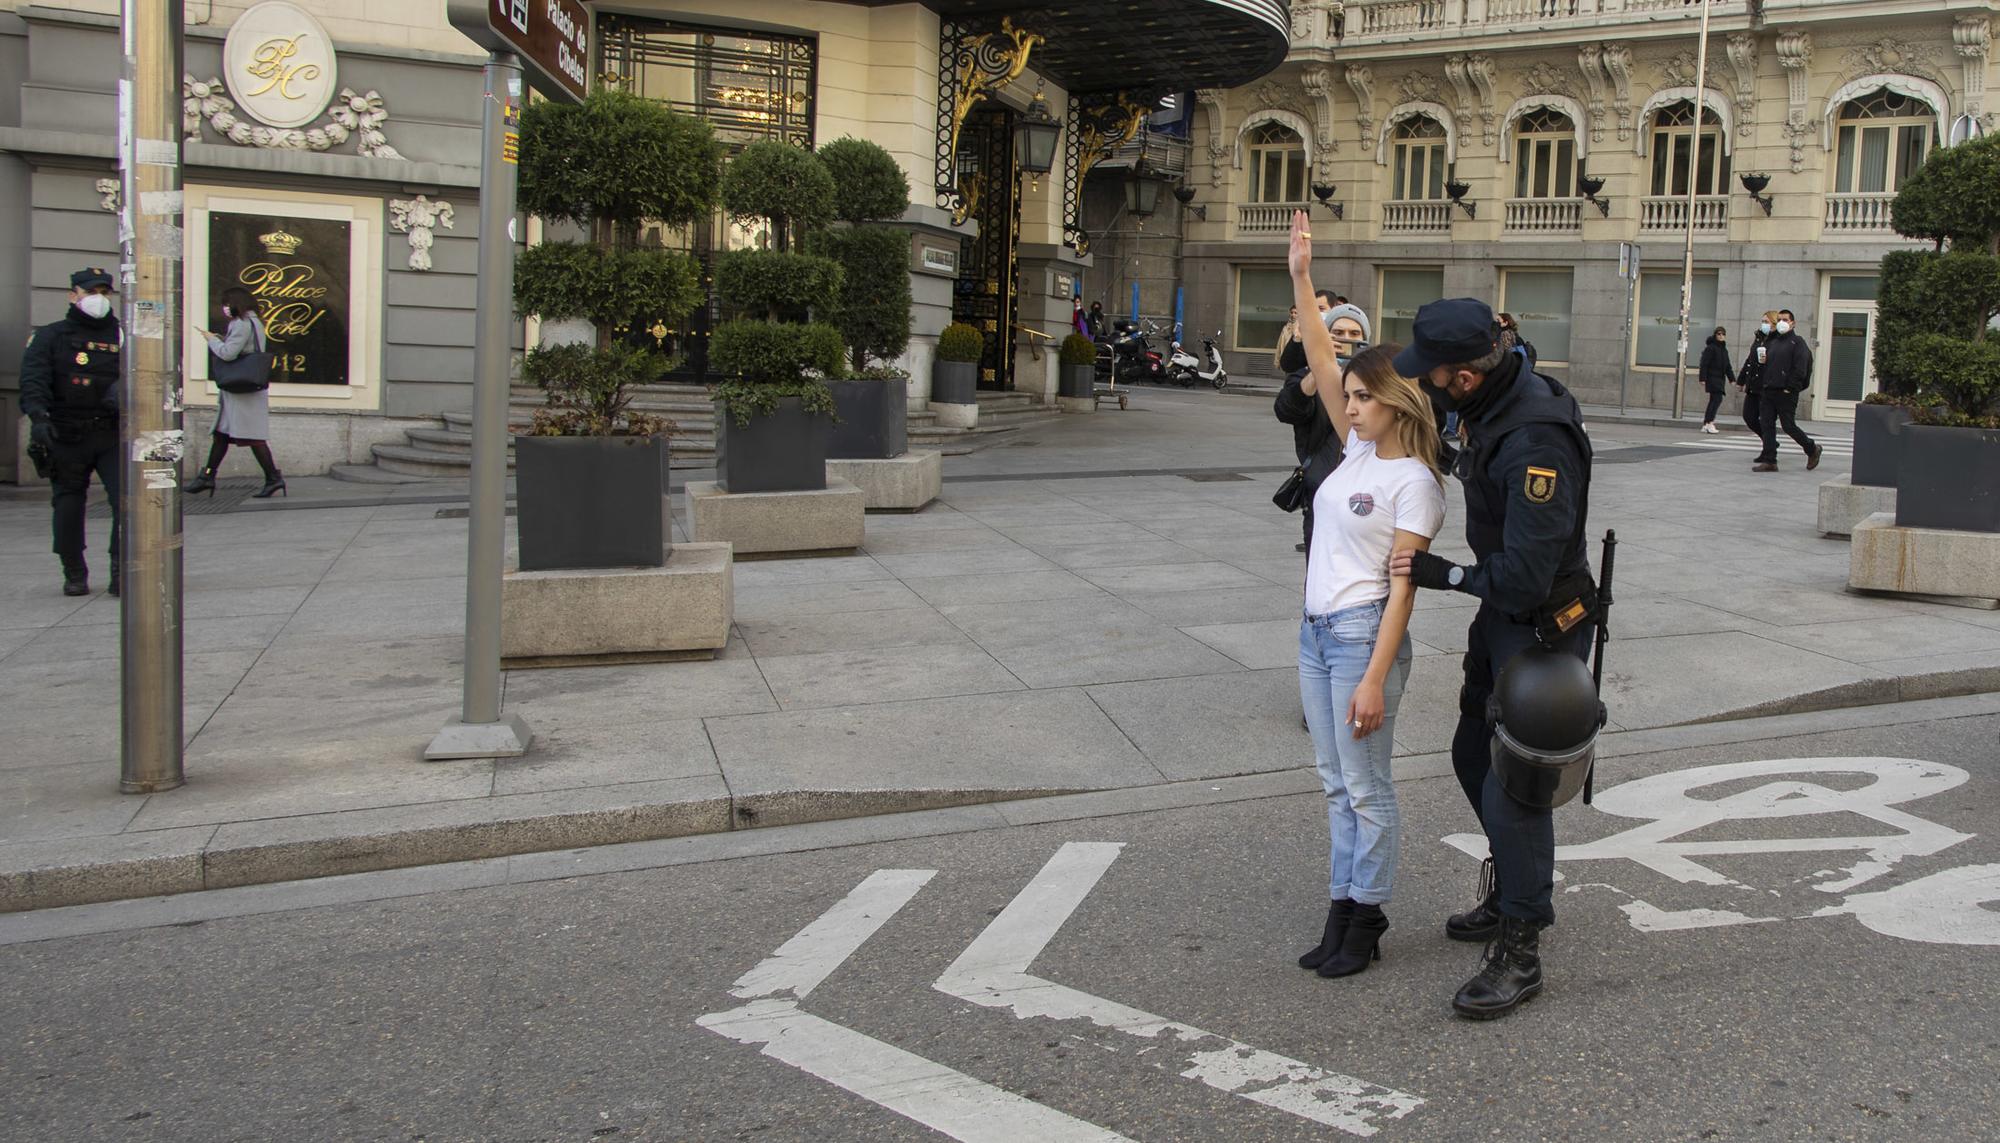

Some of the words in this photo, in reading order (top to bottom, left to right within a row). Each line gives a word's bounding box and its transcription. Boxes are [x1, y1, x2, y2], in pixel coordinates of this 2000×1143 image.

[547, 0, 574, 42] Palacio
[577, 24, 586, 53] de
[559, 41, 584, 86] Cibeles
[239, 262, 327, 299] Palace
